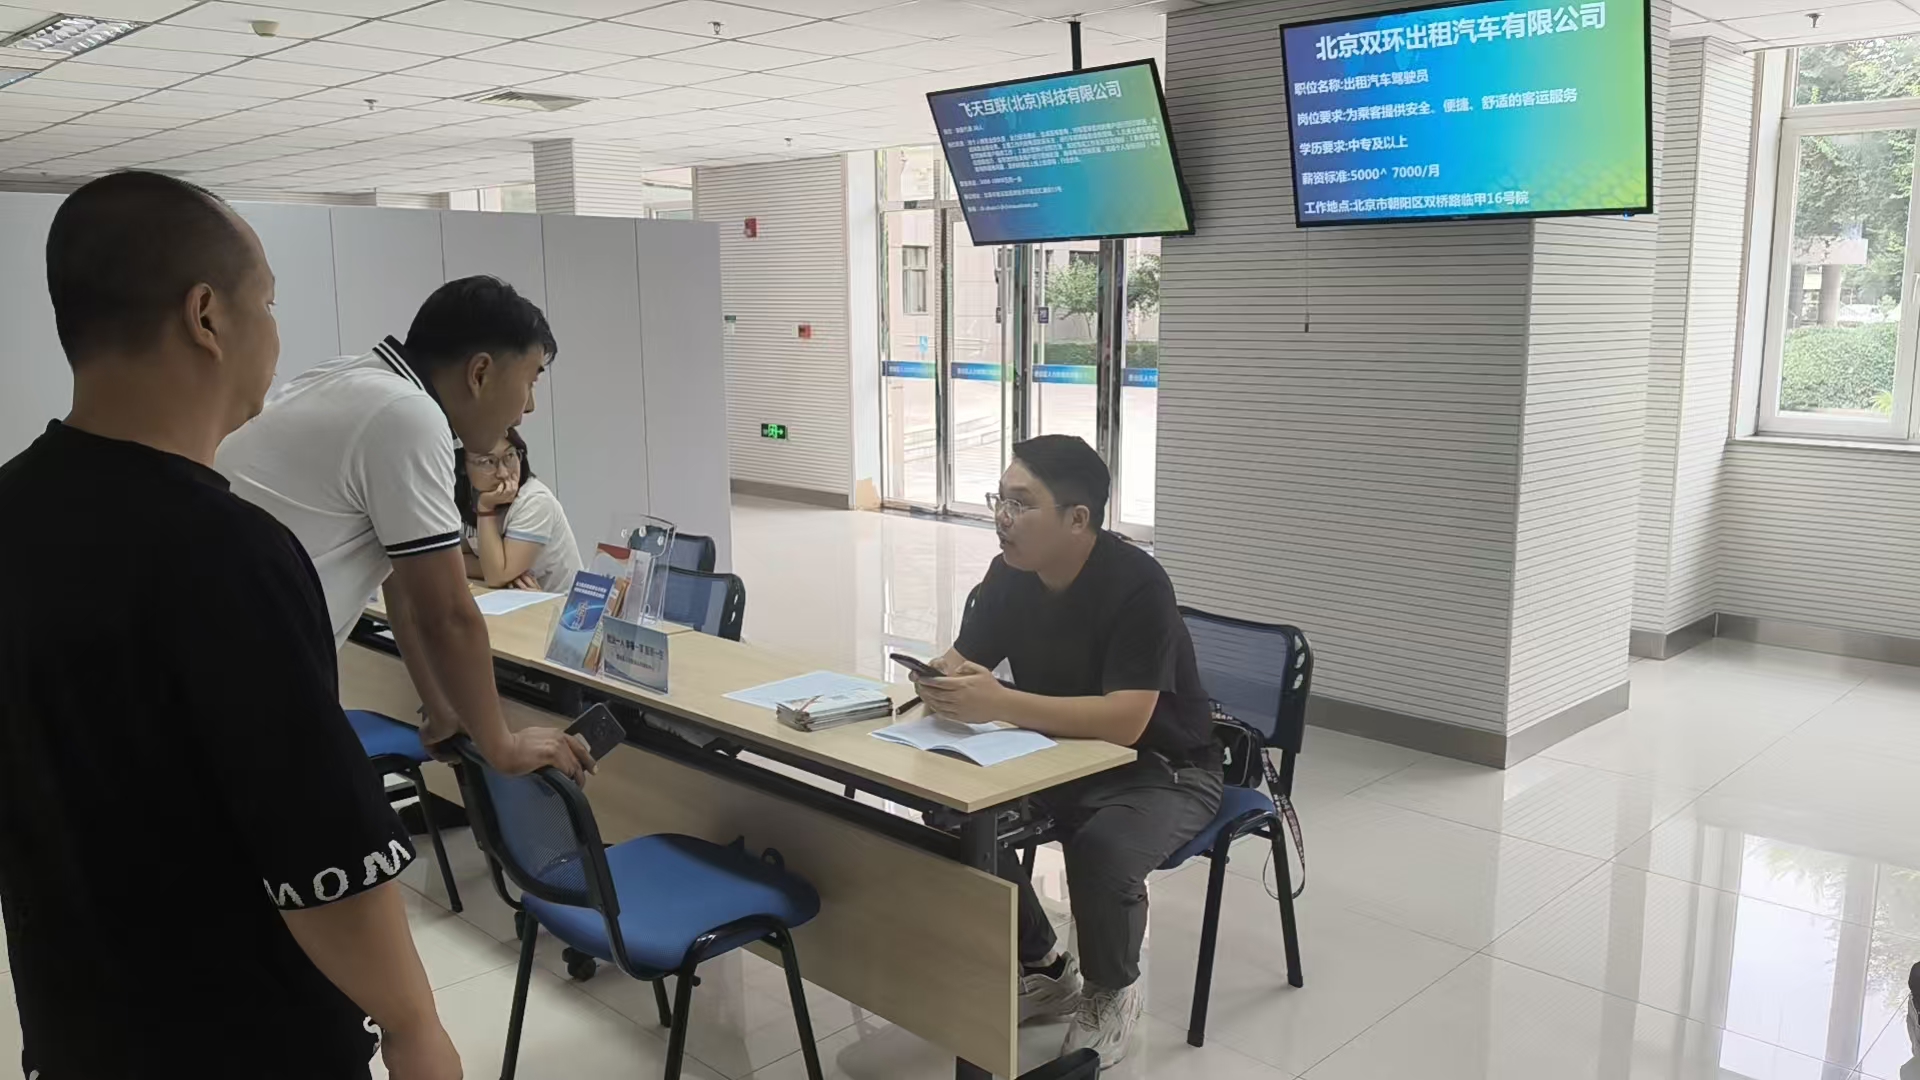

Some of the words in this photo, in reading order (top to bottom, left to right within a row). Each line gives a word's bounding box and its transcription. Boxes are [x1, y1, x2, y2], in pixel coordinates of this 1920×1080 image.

[1315, 1, 1606, 62] 北京双环出租汽车有限公司
[1294, 69, 1429, 97] 职位名称:出租汽车驾驶员
[959, 80, 1122, 118] 飞天互联(北京)科技有限公司
[1299, 134, 1408, 156] 学历要求:中专及以上
[1304, 190, 1530, 215] 工作地点:北京市朝阳区双桥路临甲16号院
